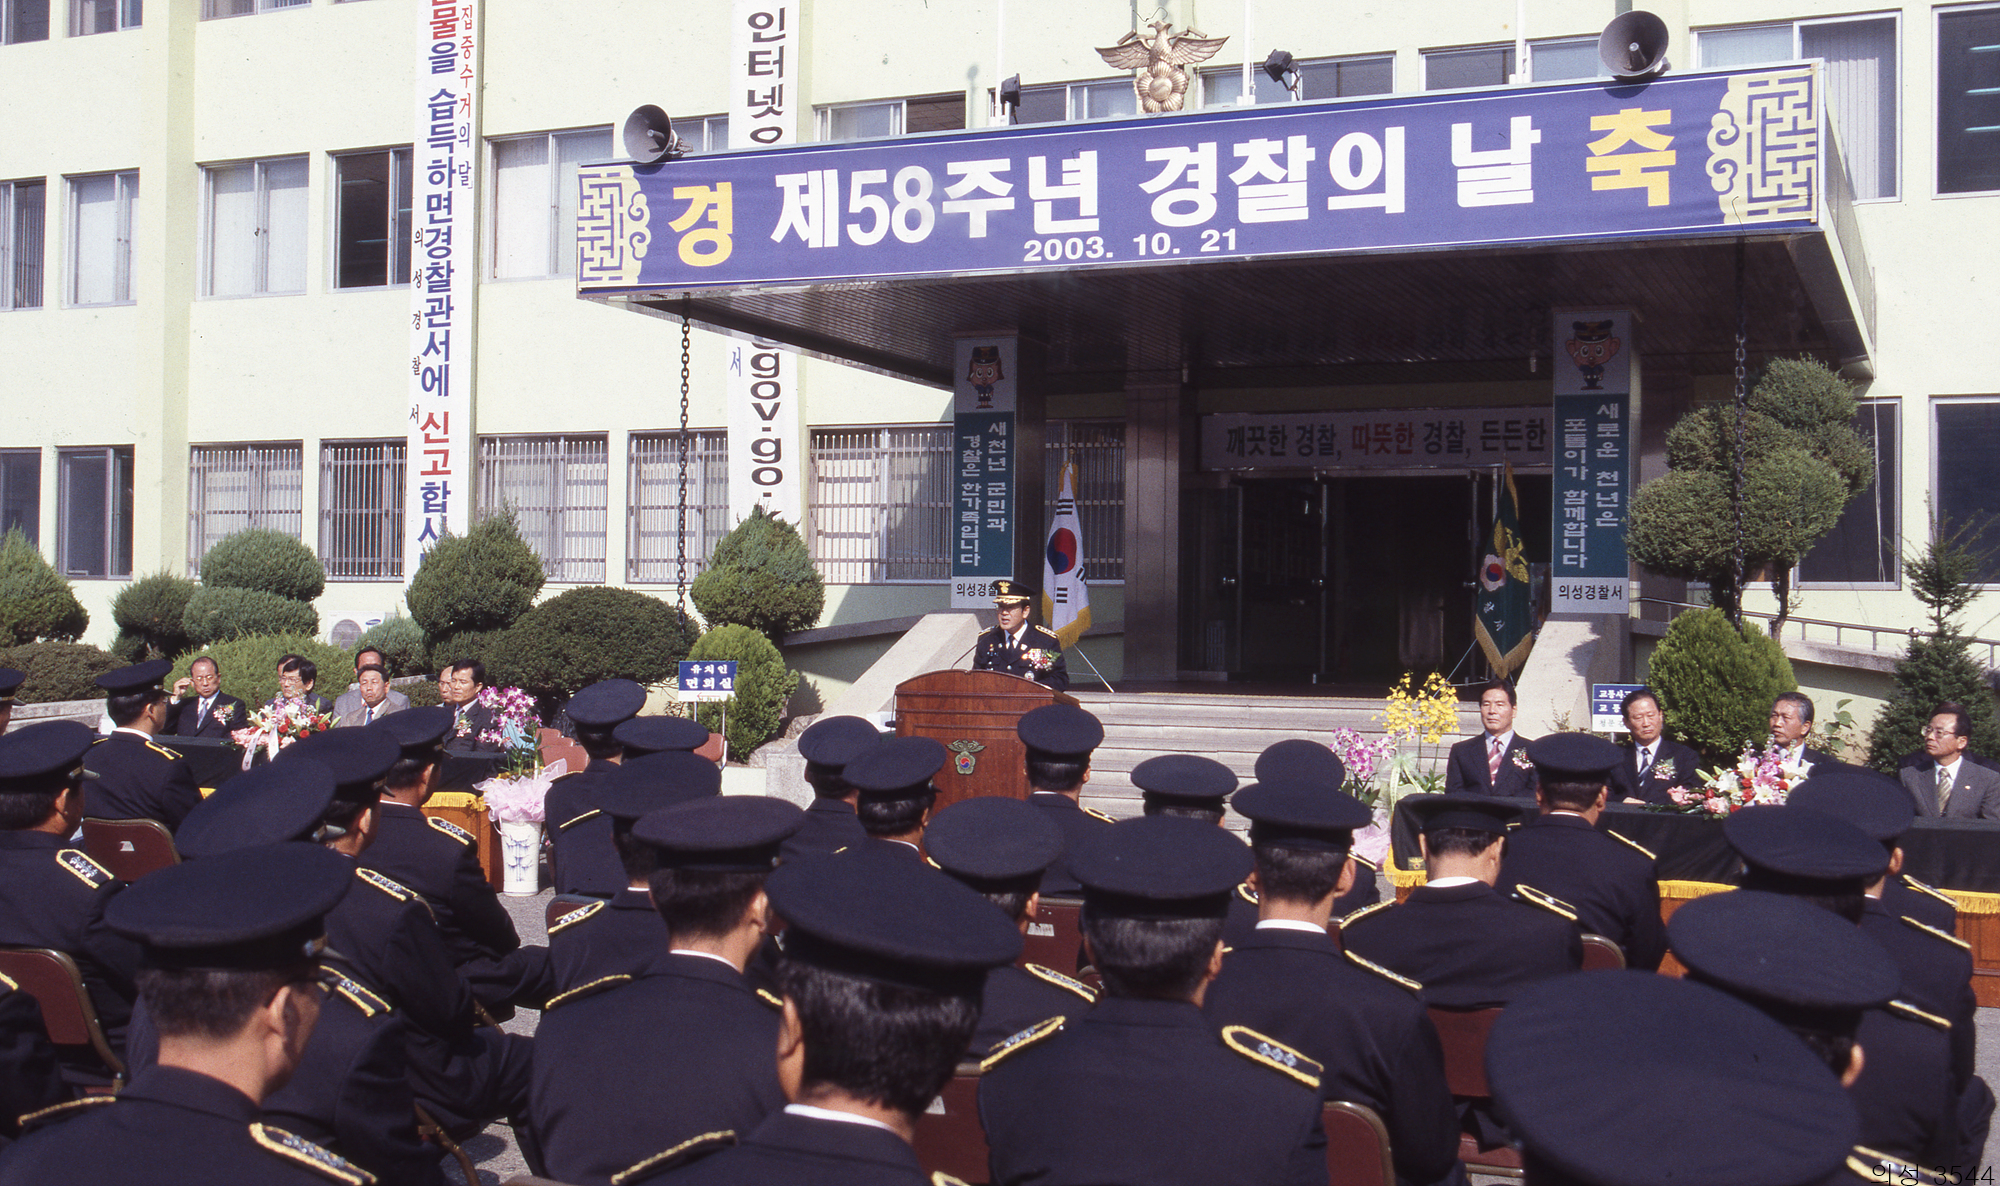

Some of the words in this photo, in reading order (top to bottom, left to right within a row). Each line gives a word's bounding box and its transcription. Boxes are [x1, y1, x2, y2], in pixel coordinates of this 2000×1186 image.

[428, 0, 460, 75] 물을
[459, 4, 475, 148] 집중수거의
[668, 181, 734, 267] 경
[771, 150, 1100, 249] 제58주년
[1138, 127, 1406, 228] 경찰의
[1451, 115, 1542, 208] 날
[1586, 107, 1677, 208] 축
[1023, 236, 1114, 262] 2003.
[1133, 233, 1180, 257] 10.
[1200, 228, 1238, 252] 21
[961, 434, 982, 477] 경찰은
[987, 421, 1007, 472] 새천년
[1226, 424, 1288, 458] 깨끗한
[1295, 423, 1342, 461] 경찰,
[1351, 422, 1415, 456] 따뜻한
[1423, 420, 1471, 459] 경찰,
[1480, 418, 1547, 452] 든든한
[1563, 418, 1589, 481] 포돌이가
[1596, 403, 1620, 458] 새로운
[417, 411, 451, 562] 신고합시
[986, 482, 1007, 532] 군민과
[1595, 471, 1620, 528] 천년은
[960, 482, 982, 566] 한가족입니다
[1562, 489, 1589, 569] 함께합니다
[1559, 584, 1623, 600] 의성경찰서
[685, 677, 732, 690] 면회실
[690, 664, 728, 675] 유치인
